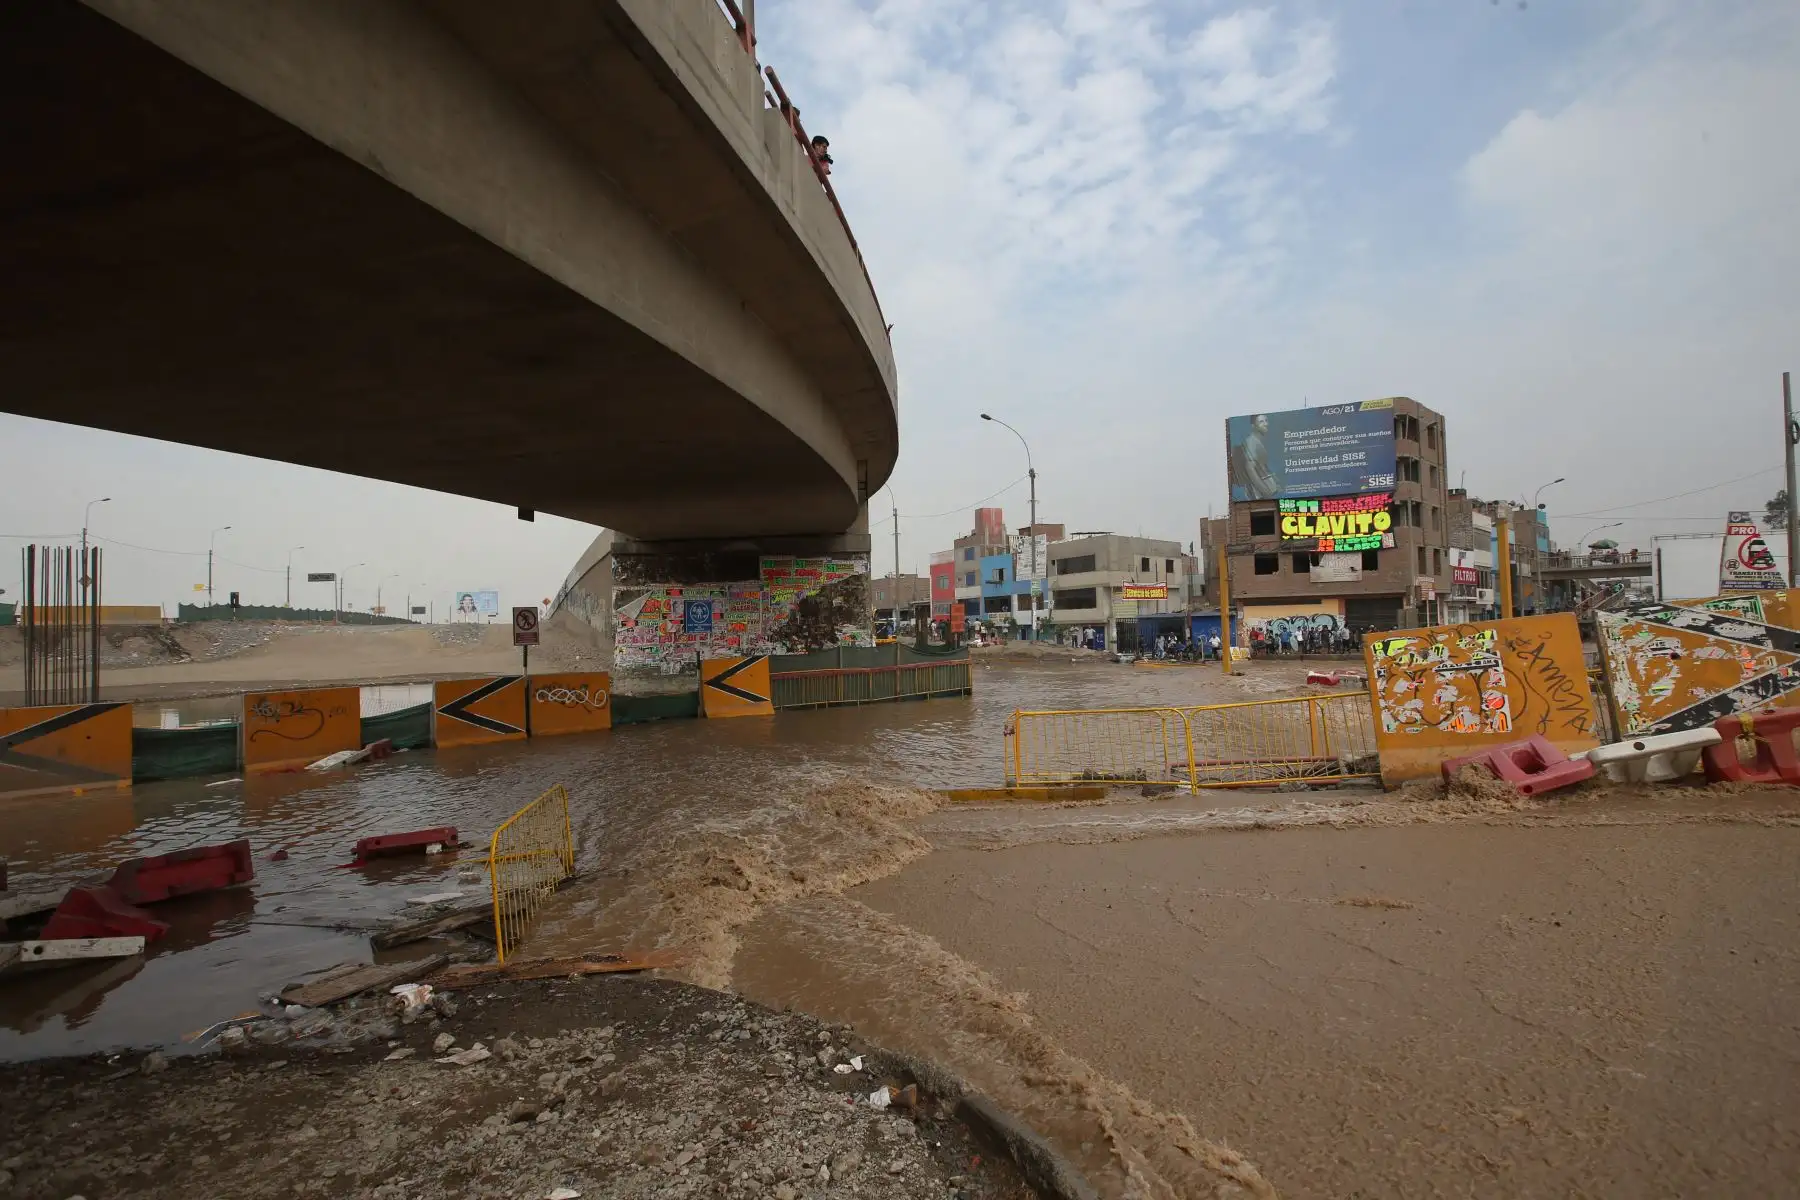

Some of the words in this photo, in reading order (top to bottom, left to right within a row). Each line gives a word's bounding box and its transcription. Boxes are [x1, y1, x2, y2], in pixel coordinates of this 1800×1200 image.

[1322, 405, 1354, 416] AGO/21
[1284, 425, 1347, 439] Emprendedor
[1322, 434, 1354, 442] construye
[1285, 455, 1339, 467] Universidad
[1342, 452, 1366, 461] SISE
[1368, 476, 1394, 486] SISE
[1296, 500, 1318, 512] 11
[1281, 511, 1391, 536] CLAVITO
[1454, 569, 1476, 582] FILTROS
